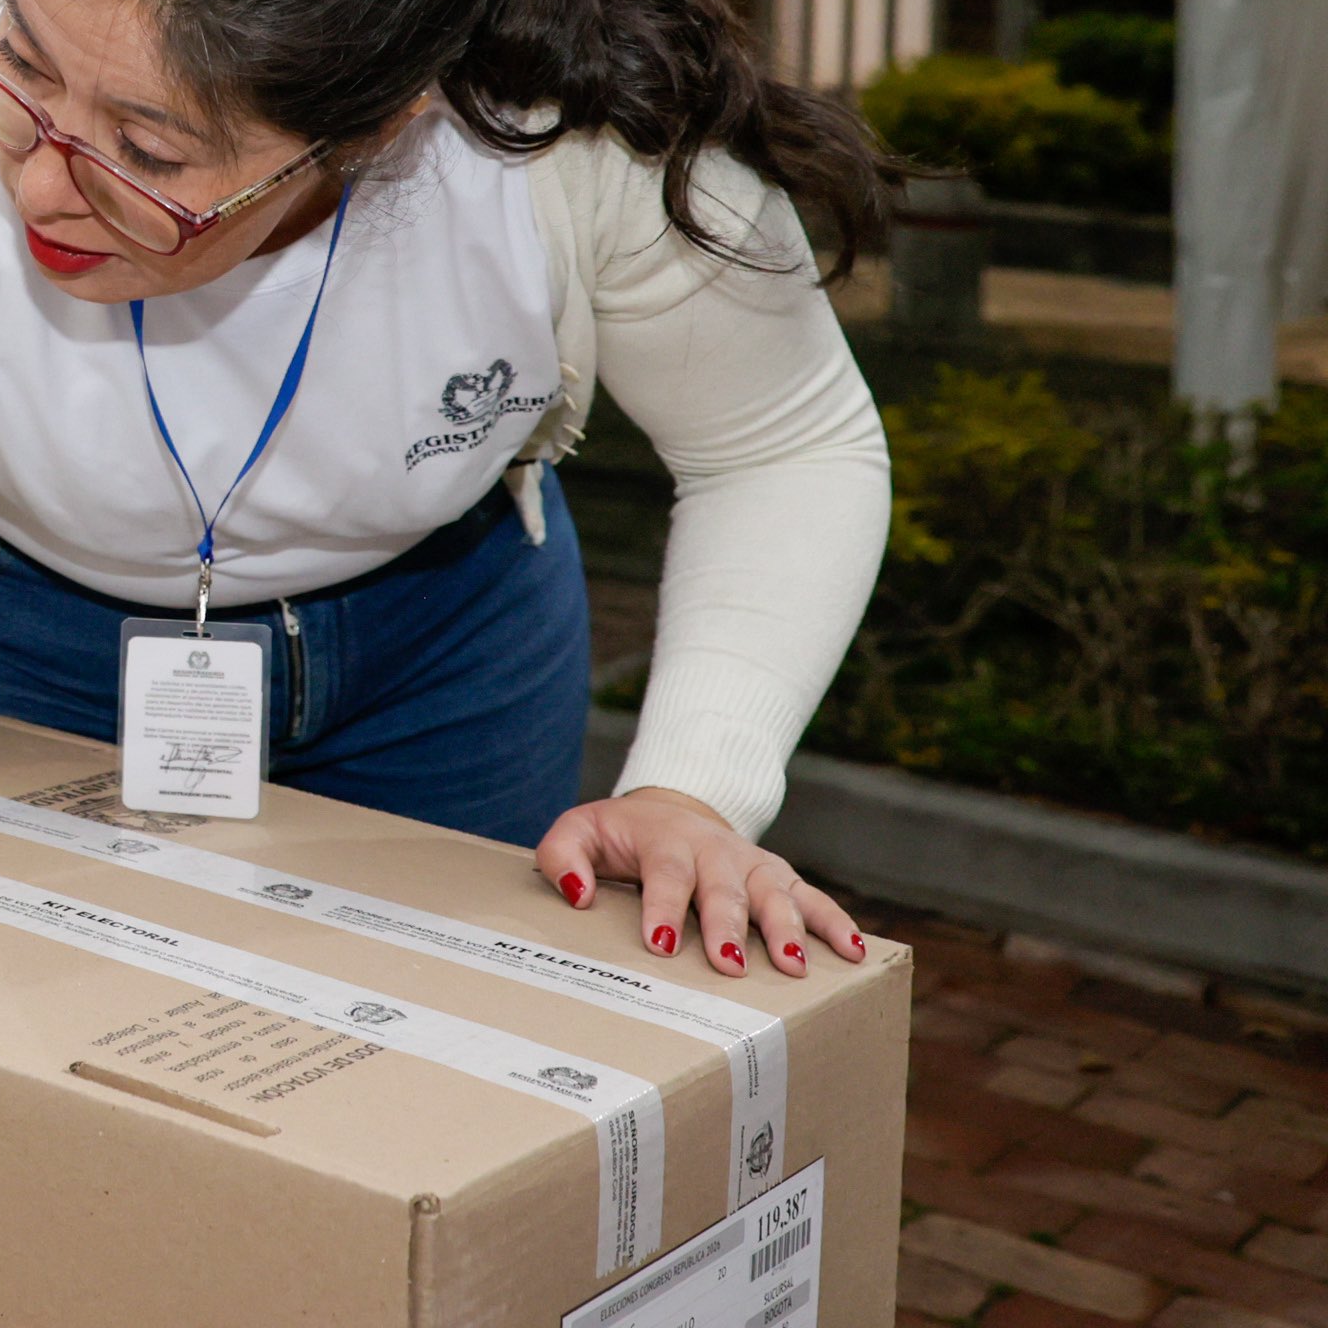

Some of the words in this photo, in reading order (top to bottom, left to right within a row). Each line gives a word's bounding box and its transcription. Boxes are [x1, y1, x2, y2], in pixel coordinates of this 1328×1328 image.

[42, 901, 72, 914] KIT
[78, 910, 179, 947] ELECTORAL
[494, 941, 530, 955] KIT
[535, 953, 653, 992] ELECTORAL
[629, 1110, 637, 1175] SEÑORES
[629, 1179, 637, 1242] JURADOS
[758, 1188, 807, 1242] 119,387
[600, 1292, 638, 1322] ELECCIONES
[640, 1272, 672, 1299] CONGRESO
[706, 1241, 721, 1258] 2026
[764, 1276, 793, 1305] SUCURSAL
[764, 1300, 792, 1325] BOGOTA
